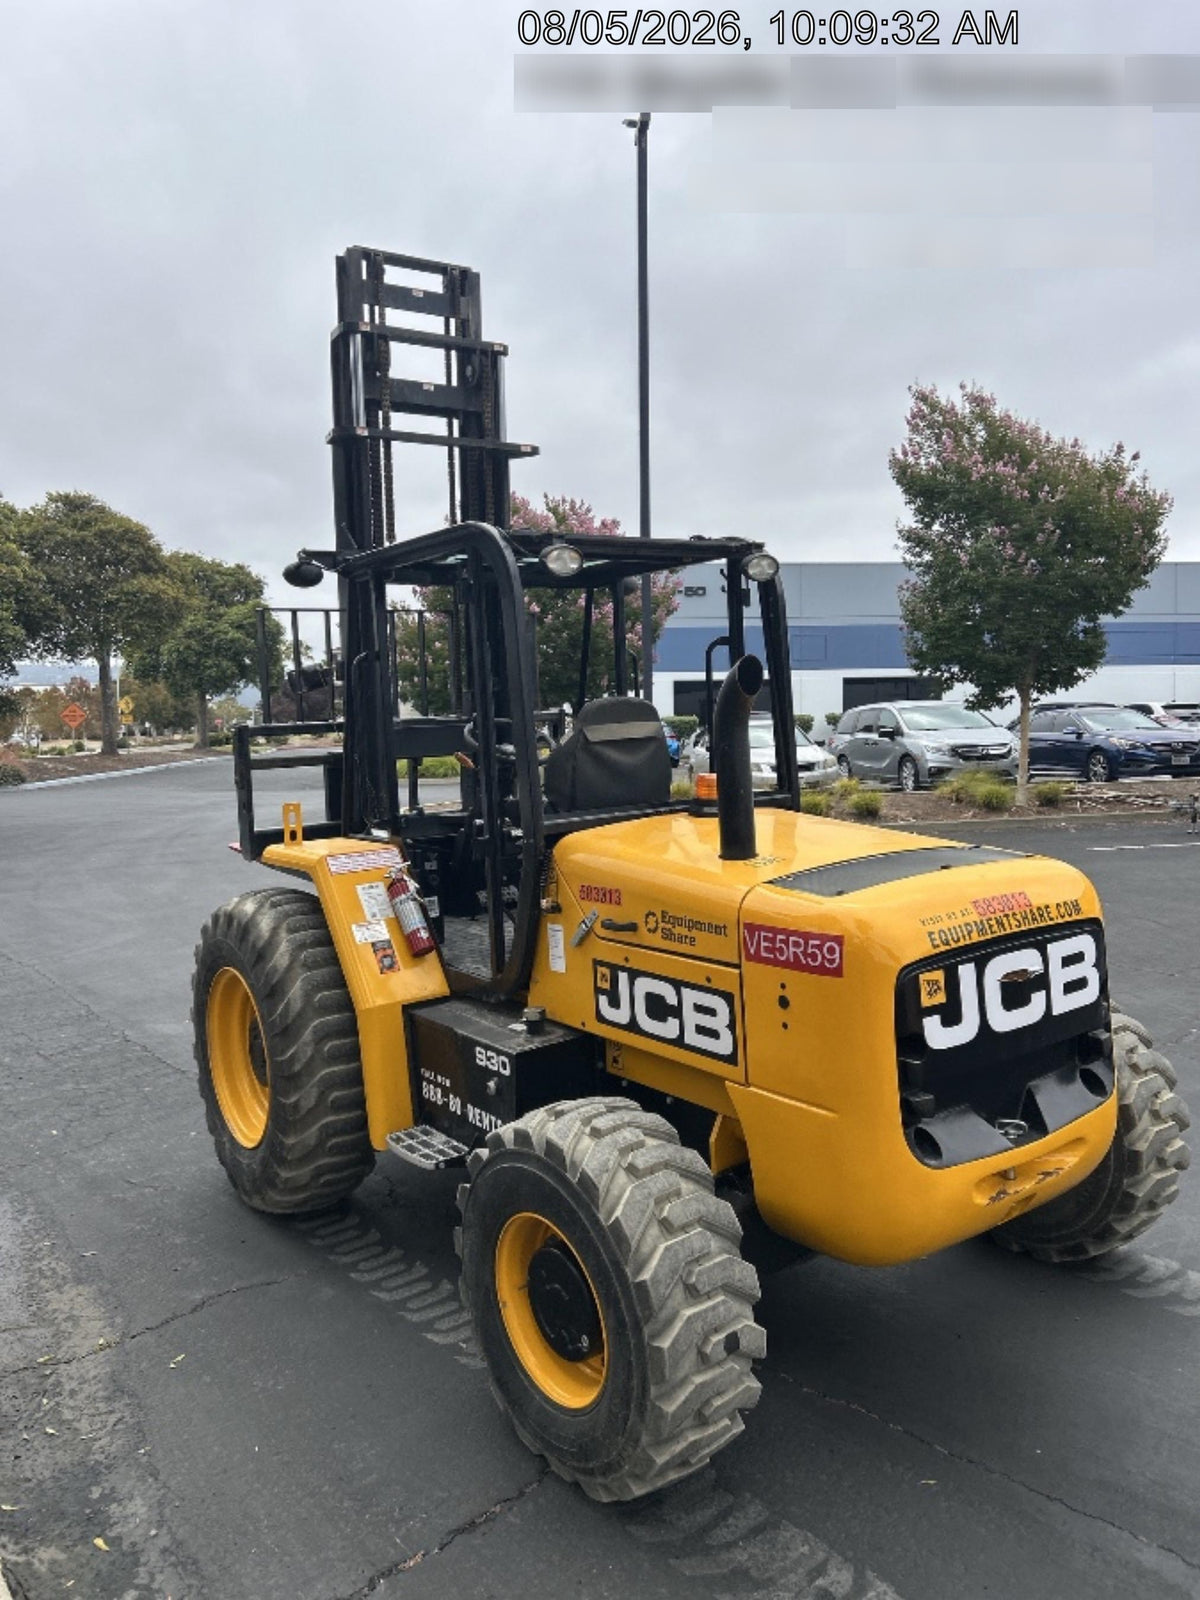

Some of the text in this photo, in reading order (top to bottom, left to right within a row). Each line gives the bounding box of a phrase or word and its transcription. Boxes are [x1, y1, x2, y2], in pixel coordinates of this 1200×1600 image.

[661, 910, 728, 937] Equipment
[661, 928, 696, 946] Share
[928, 900, 1082, 949] EQUIPMENTSHARE.COM
[745, 928, 841, 968] VE5R59
[922, 934, 1100, 1050] JCB
[598, 972, 734, 1056] JCB
[475, 1047, 511, 1076] 930
